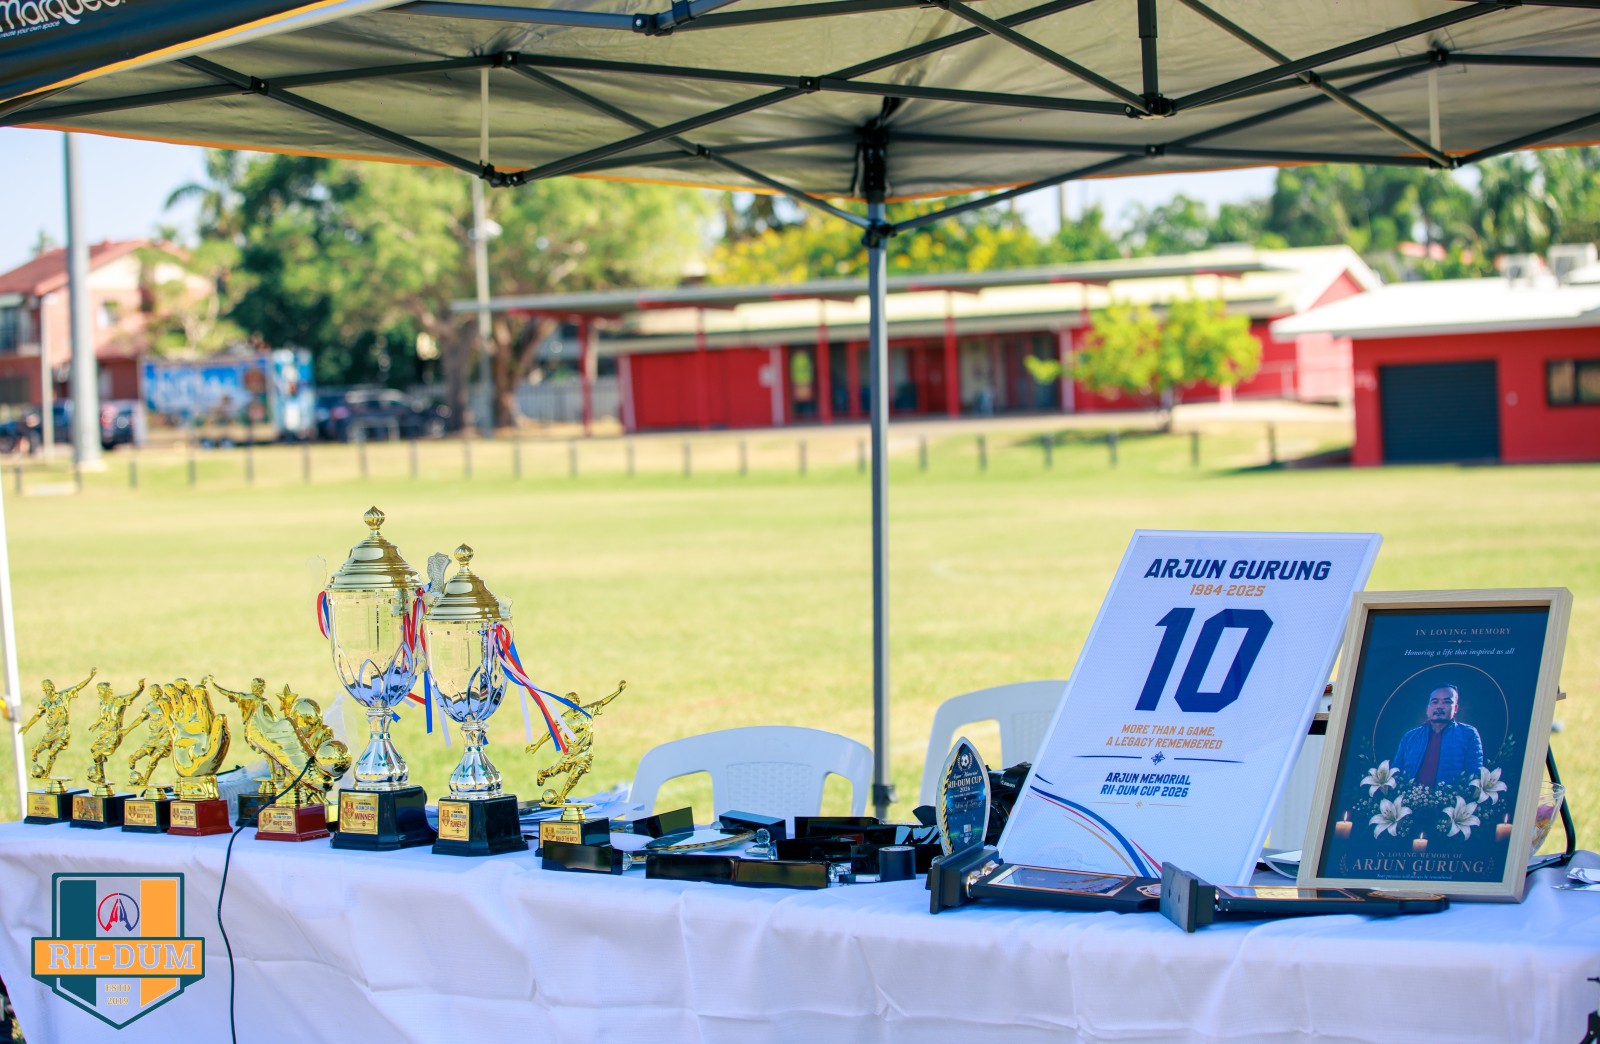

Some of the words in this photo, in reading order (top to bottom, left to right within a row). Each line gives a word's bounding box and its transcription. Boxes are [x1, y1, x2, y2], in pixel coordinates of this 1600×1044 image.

[1144, 558, 1227, 579] ARJUN
[1229, 559, 1332, 581] GURUNG
[1189, 583, 1266, 597] 1984-2025
[1430, 628, 1467, 636] LOVING
[1470, 627, 1512, 635] MEMORY
[1404, 649, 1435, 658] Honoring
[1442, 648, 1454, 657] life
[1469, 647, 1496, 657] inspired
[1505, 647, 1516, 655] all
[1135, 607, 1274, 713] 10
[1121, 724, 1150, 734] MORE
[1151, 725, 1177, 735] THAN
[1177, 726, 1185, 735] A
[1106, 736, 1113, 746] A
[1114, 736, 1154, 747] LEGACY
[1155, 738, 1223, 750] REMEMBERED
[971, 775, 983, 785] CUP
[1105, 772, 1140, 784] ARJUN
[1139, 773, 1191, 785] MEMORIAL
[1100, 784, 1139, 796] RII-DUM
[1140, 785, 1161, 796] CUP
[1161, 786, 1189, 798] 2026
[354, 812, 375, 821] WINNER
[1352, 858, 1406, 871] ARJUN
[1412, 860, 1484, 873] GURUNG
